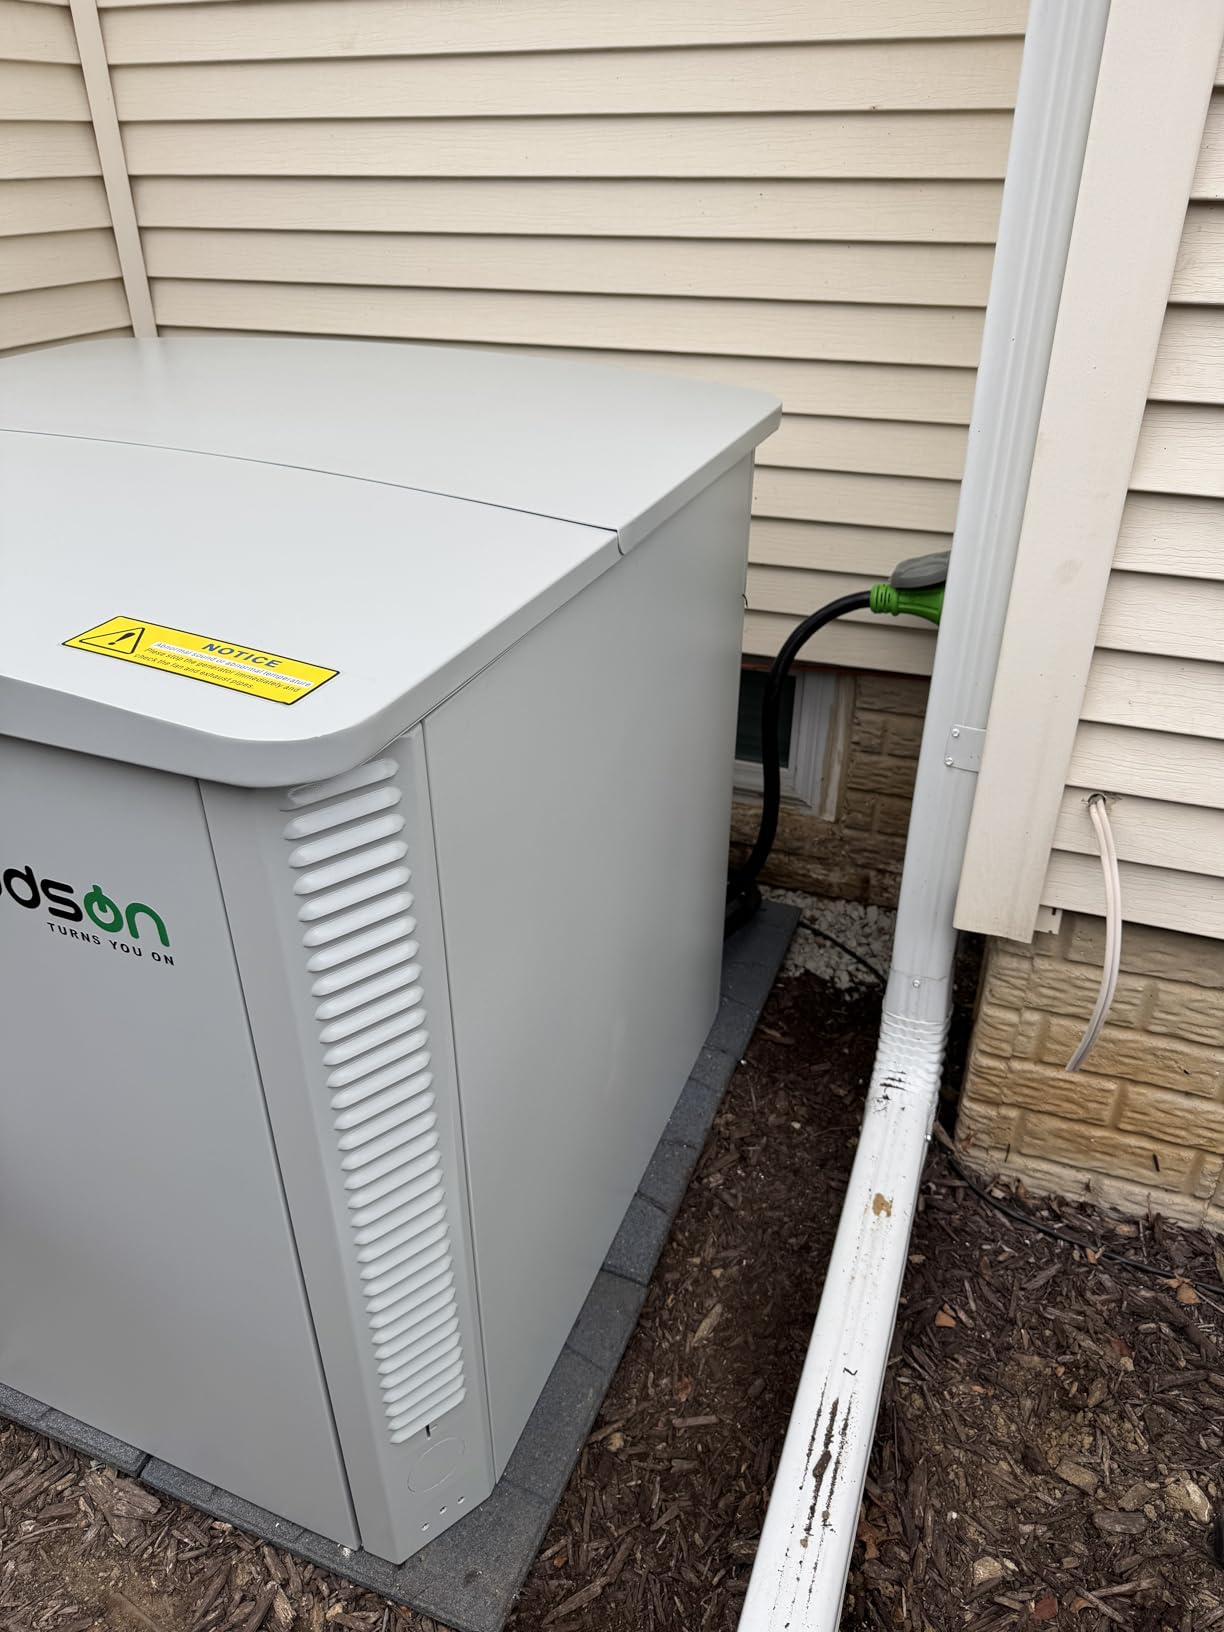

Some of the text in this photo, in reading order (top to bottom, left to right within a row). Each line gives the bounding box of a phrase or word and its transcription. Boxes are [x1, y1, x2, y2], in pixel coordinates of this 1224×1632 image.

[134, 653, 156, 663] check
[170, 662, 183, 670] fan
[183, 666, 200, 674] and
[199, 670, 230, 683] exhaust
[154, 642, 192, 655] Abnormal
[191, 651, 217, 662] sound
[225, 661, 264, 674] abnormal
[263, 670, 312, 688] temperature
[165, 653, 183, 662] stop
[184, 657, 197, 665] the
[196, 660, 235, 675] generator
[235, 672, 283, 689] immediately
[283, 684, 301, 693] and
[201, 643, 283, 668] NOTICE
[0, 865, 170, 948] dson
[47, 921, 175, 967] TURNS YOU ON
